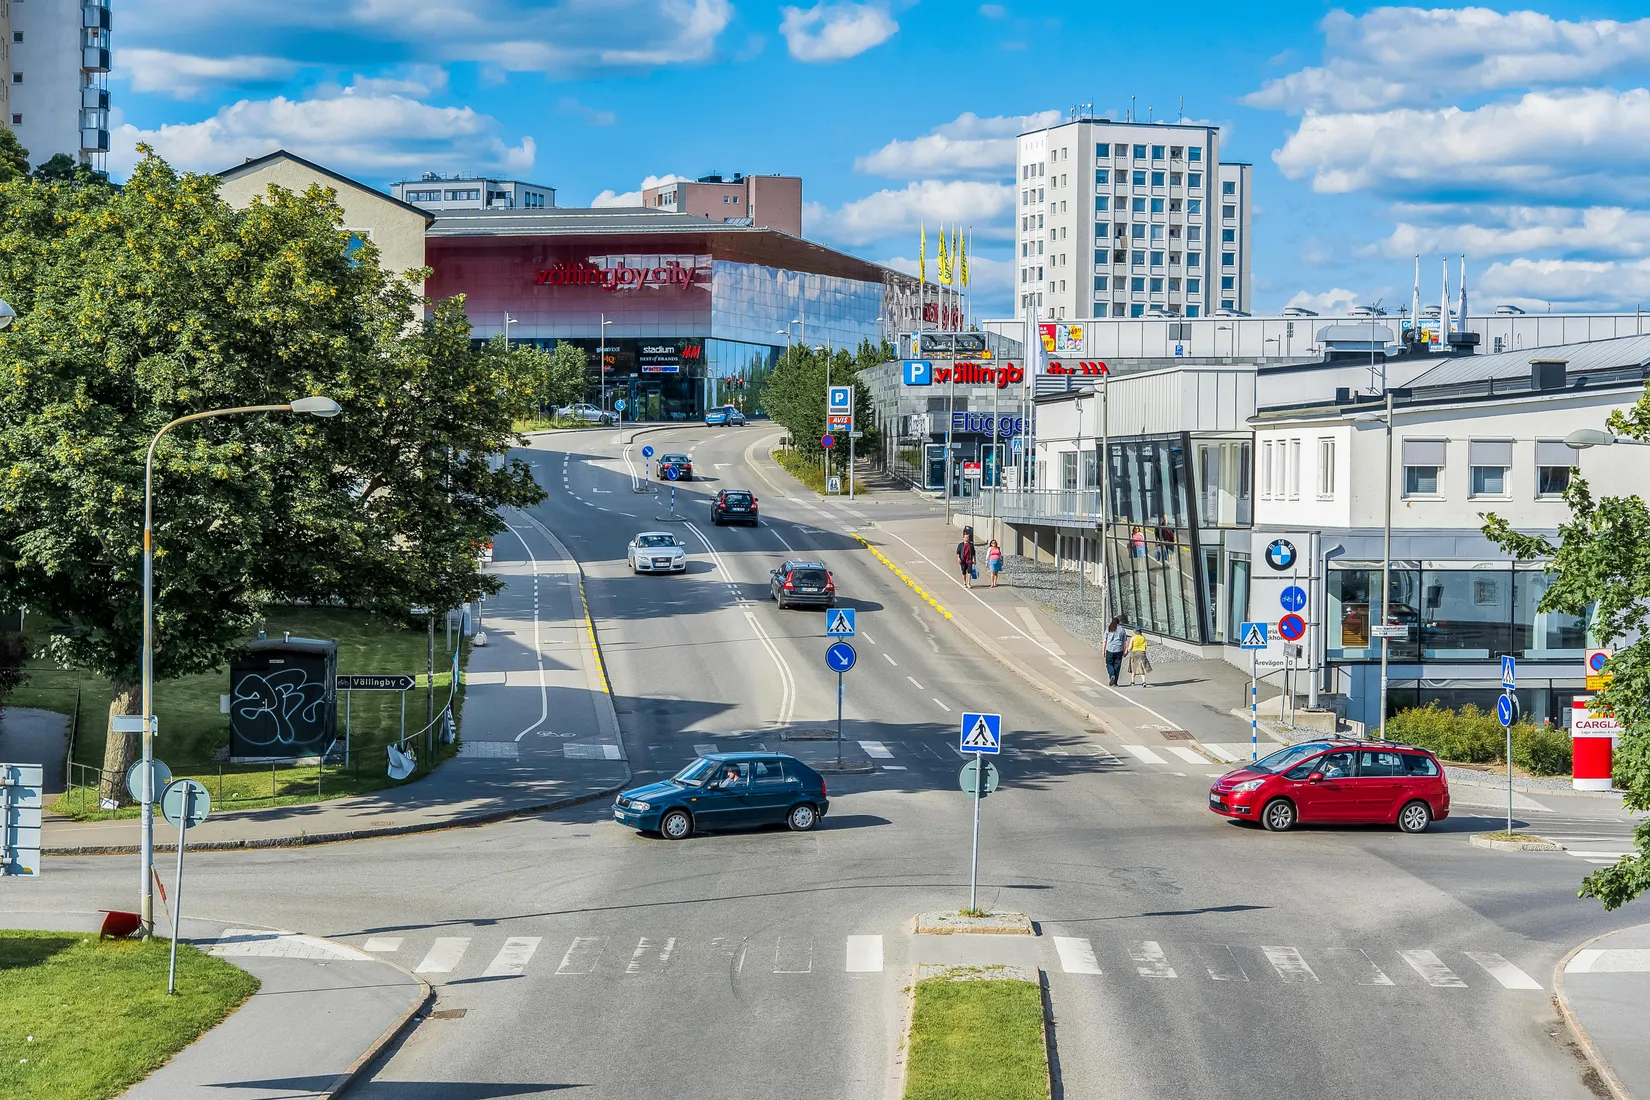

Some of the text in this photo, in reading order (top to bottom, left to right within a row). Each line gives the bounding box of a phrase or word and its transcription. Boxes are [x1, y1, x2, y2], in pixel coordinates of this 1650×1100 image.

[651, 260, 695, 291] city
[643, 346, 675, 354] stadium
[911, 363, 924, 383] P
[1268, 539, 1296, 551] BMW
[353, 678, 405, 687] Vällingby C
